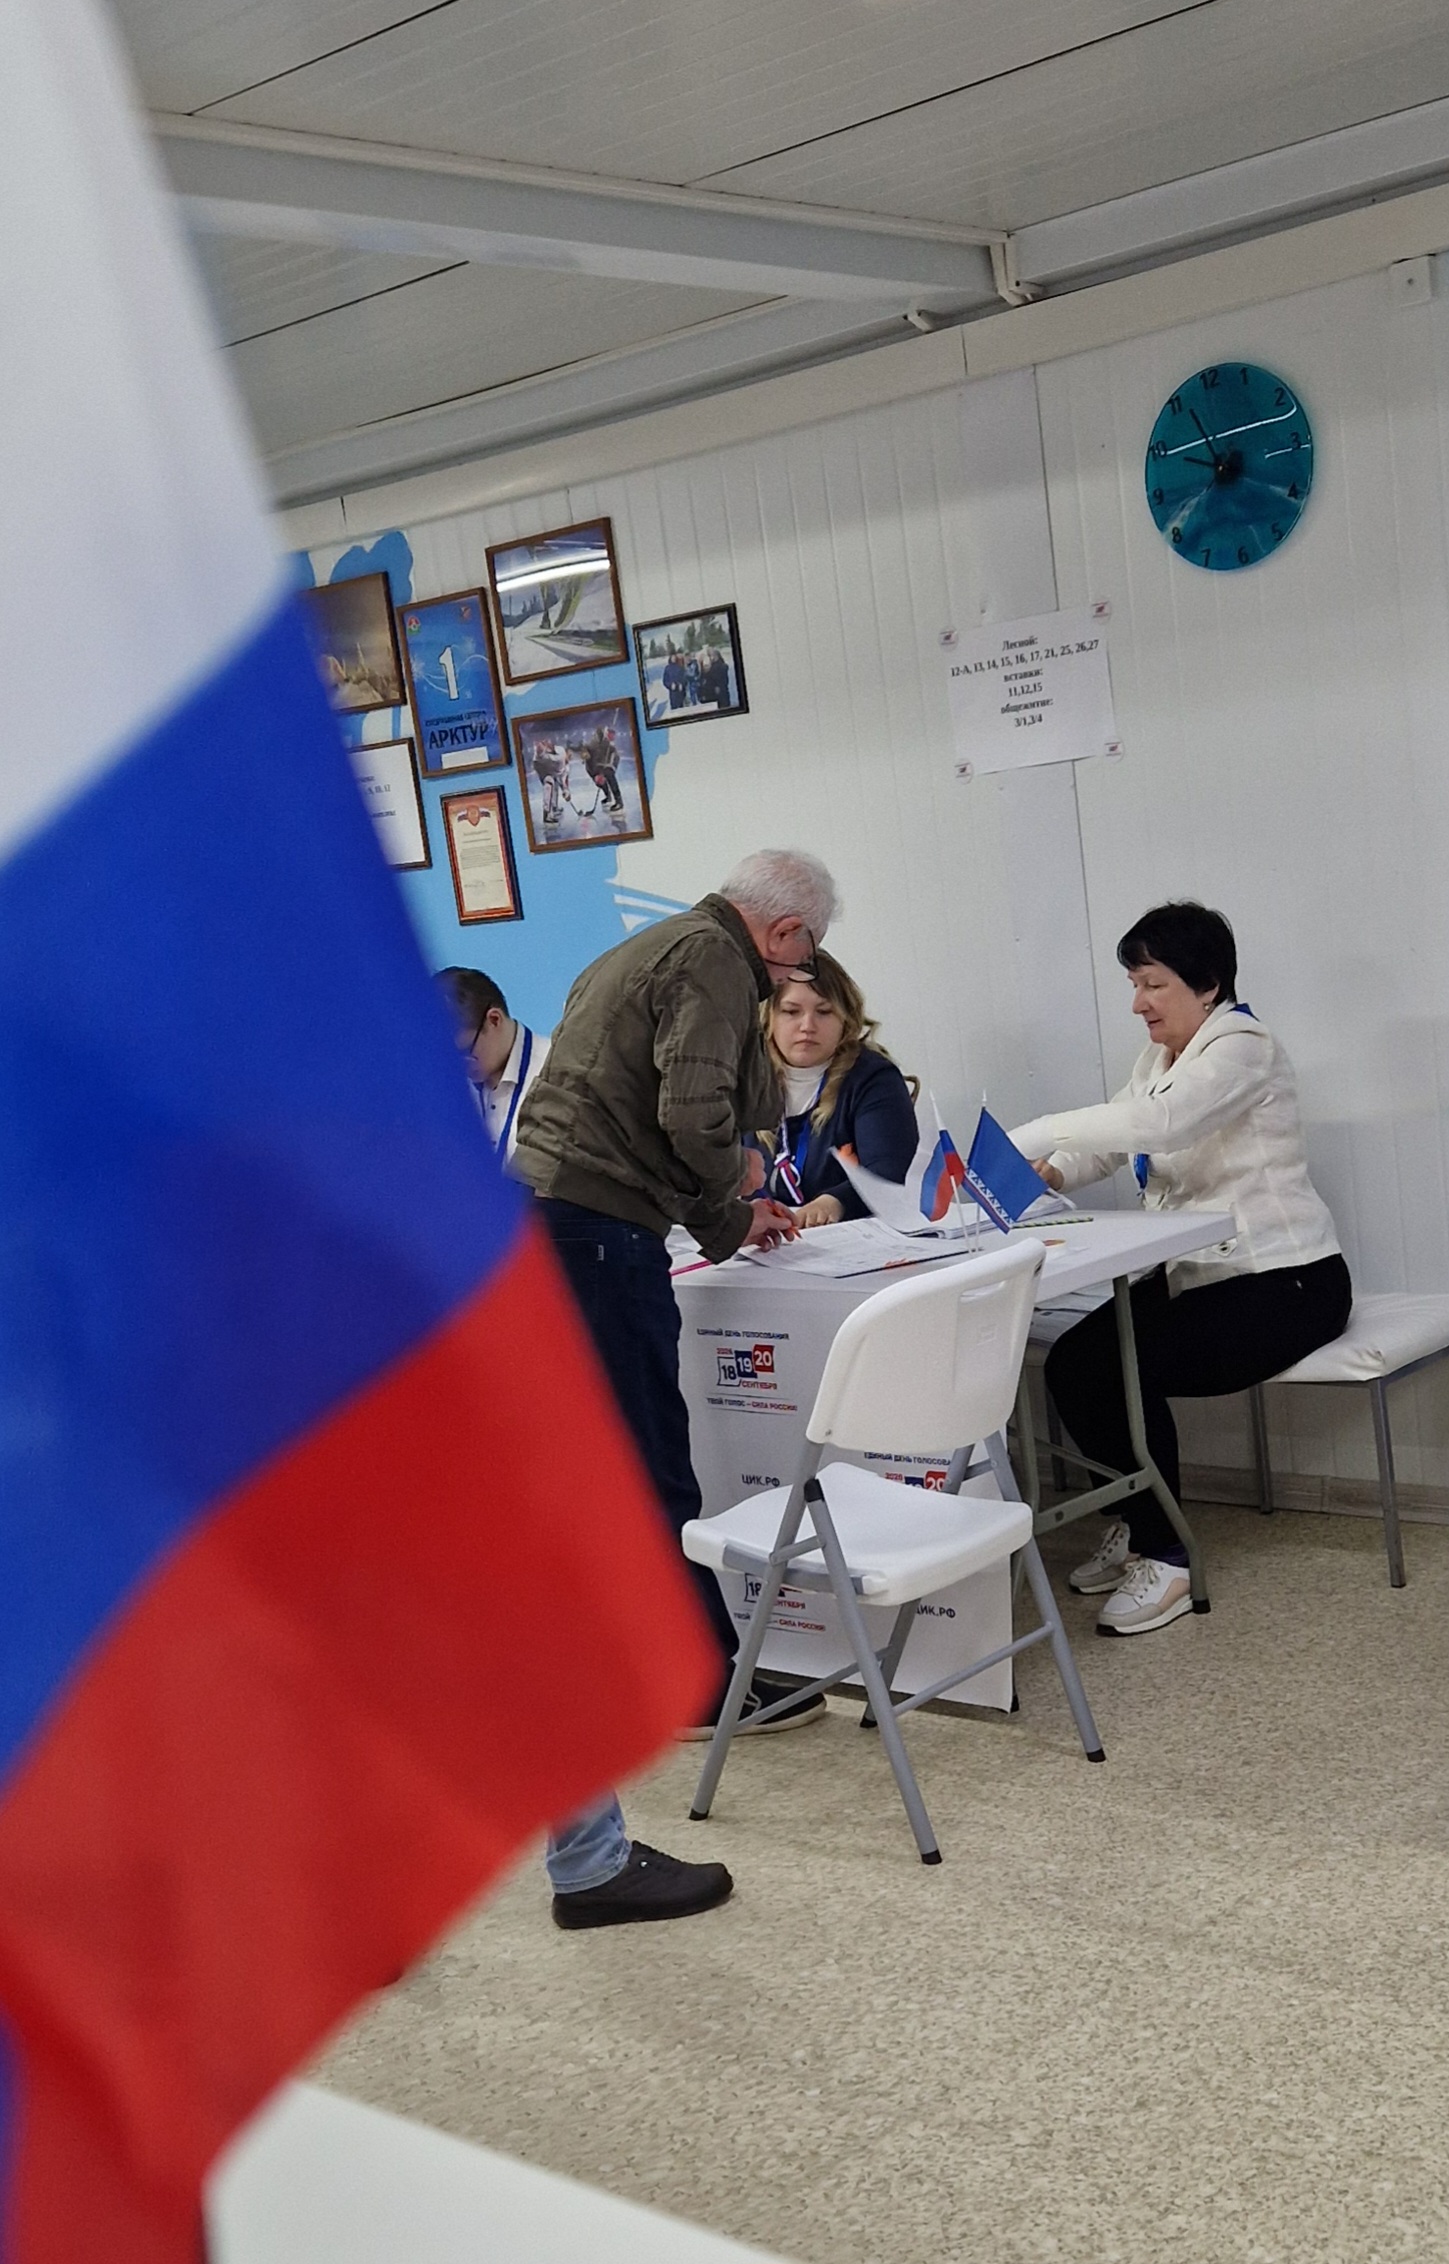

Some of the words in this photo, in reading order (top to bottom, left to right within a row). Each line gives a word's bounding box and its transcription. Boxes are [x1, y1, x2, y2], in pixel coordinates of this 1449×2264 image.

[1200, 368, 1219, 390] 12
[1240, 367, 1249, 385] 1
[1168, 394, 1183, 416] 11
[1274, 387, 1285, 406] 2
[1290, 431, 1301, 449] 3
[1149, 440, 1168, 462] 10
[1153, 487, 1164, 505] 9
[1287, 482, 1298, 499] 4
[1171, 526, 1182, 544] 8
[1271, 521, 1283, 542] 5
[1202, 548, 1211, 568] 7
[1237, 546, 1249, 565] 6
[1002, 635, 1039, 651] Лесной:
[974, 662, 985, 673] 13,
[987, 659, 999, 670] 14,
[1001, 656, 1013, 668] 15,
[1015, 653, 1028, 665] 16,
[1030, 650, 1043, 663] 17,
[1045, 648, 1058, 659] 21,
[1060, 645, 1074, 657] 25,
[438, 645, 459, 700] 1
[1003, 667, 1044, 682] вставки:
[1008, 682, 1043, 698] 11,12,15
[1000, 698, 1054, 715] общежитие:
[429, 722, 489, 749] АРКТУР
[721, 1365, 737, 1380] 18
[737, 1357, 753, 1373] 19
[754, 1350, 772, 1367] 20
[741, 1380, 778, 1390] СЕНТЯБРЯ
[741, 1473, 780, 1487] ЦИК.РФ
